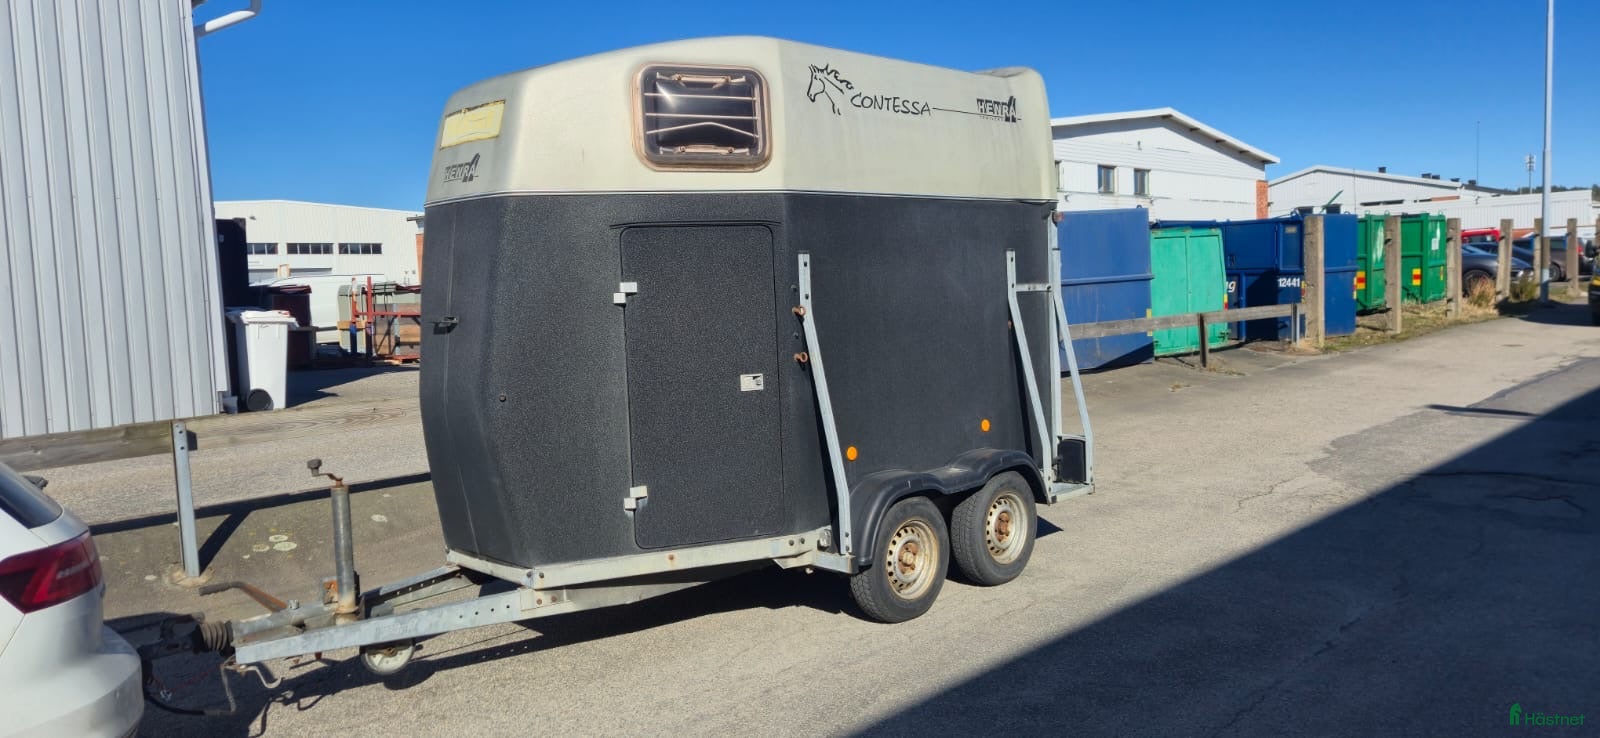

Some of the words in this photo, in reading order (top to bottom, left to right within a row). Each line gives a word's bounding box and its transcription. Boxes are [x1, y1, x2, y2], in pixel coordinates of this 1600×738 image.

[850, 92, 931, 116] CONTESSA
[976, 95, 1017, 123] HENRA
[1278, 277, 1300, 288] 12441
